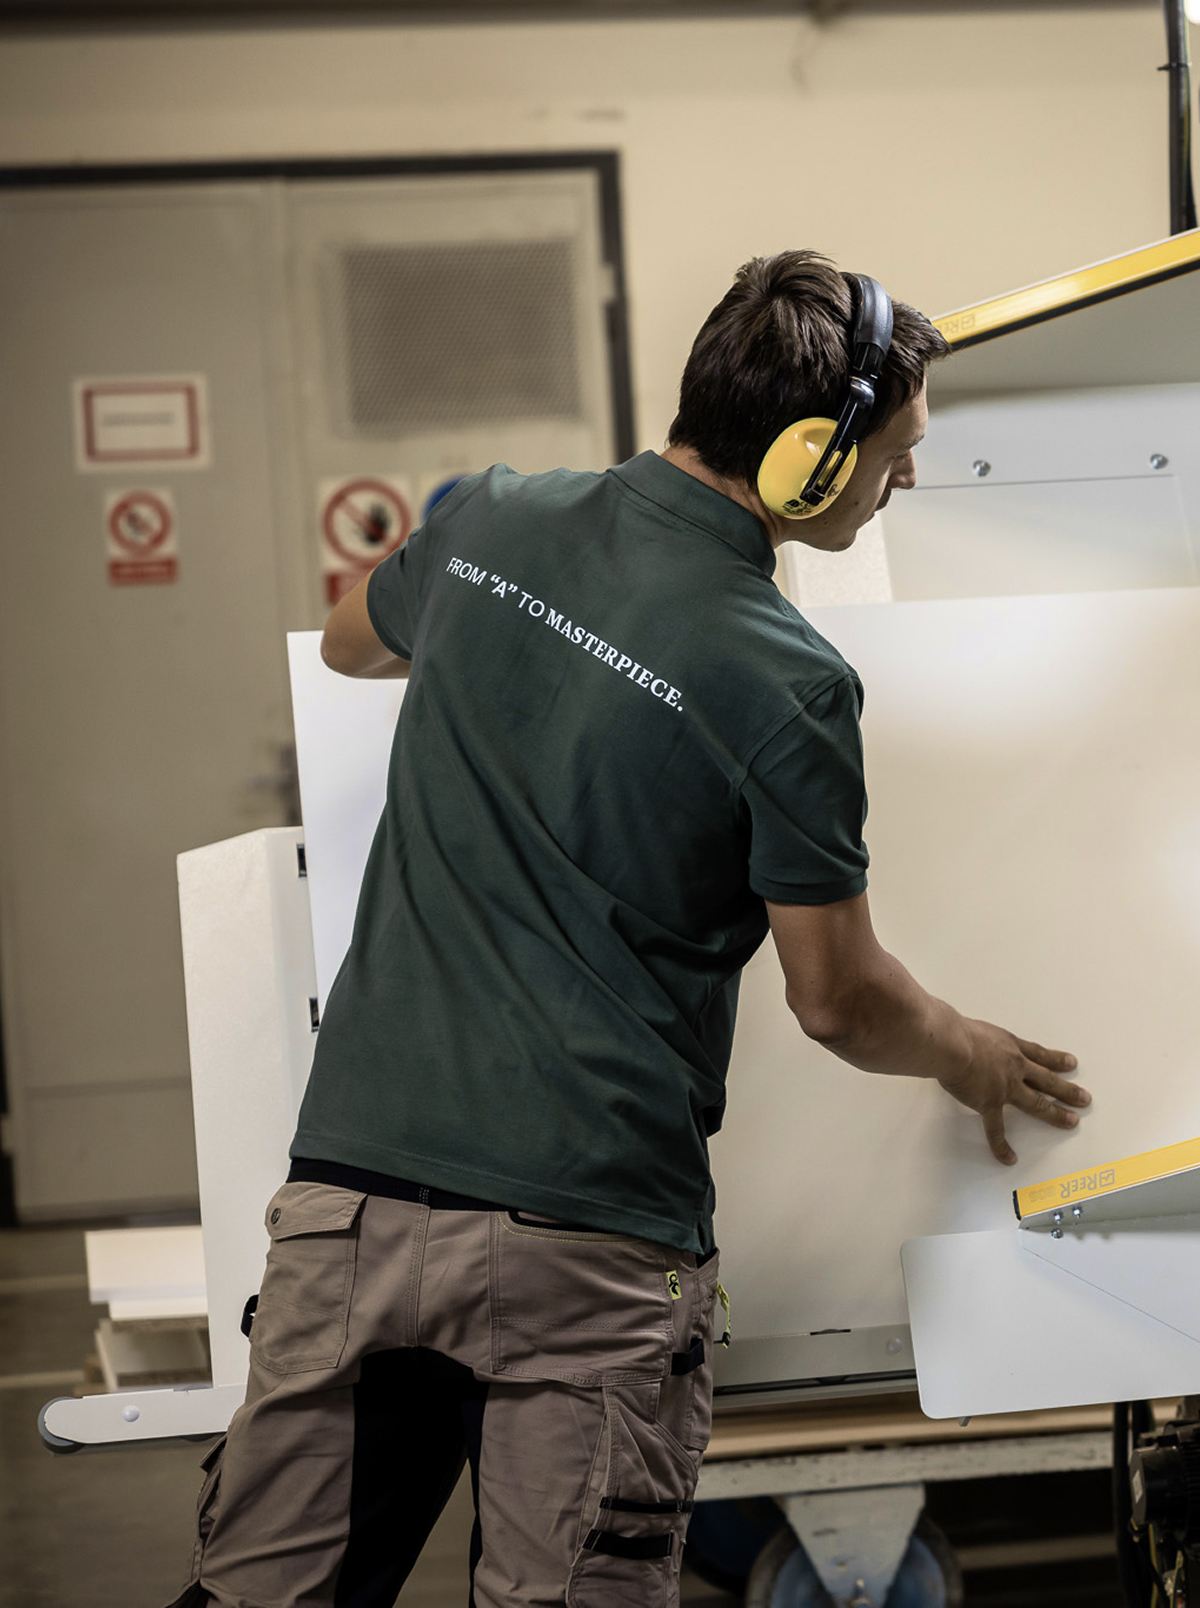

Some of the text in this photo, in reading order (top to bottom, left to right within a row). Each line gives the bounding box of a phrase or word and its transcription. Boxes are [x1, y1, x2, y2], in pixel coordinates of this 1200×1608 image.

[446, 557, 487, 585] FROM
[518, 591, 545, 617] TO
[545, 608, 683, 712] MASTERPIECE.
